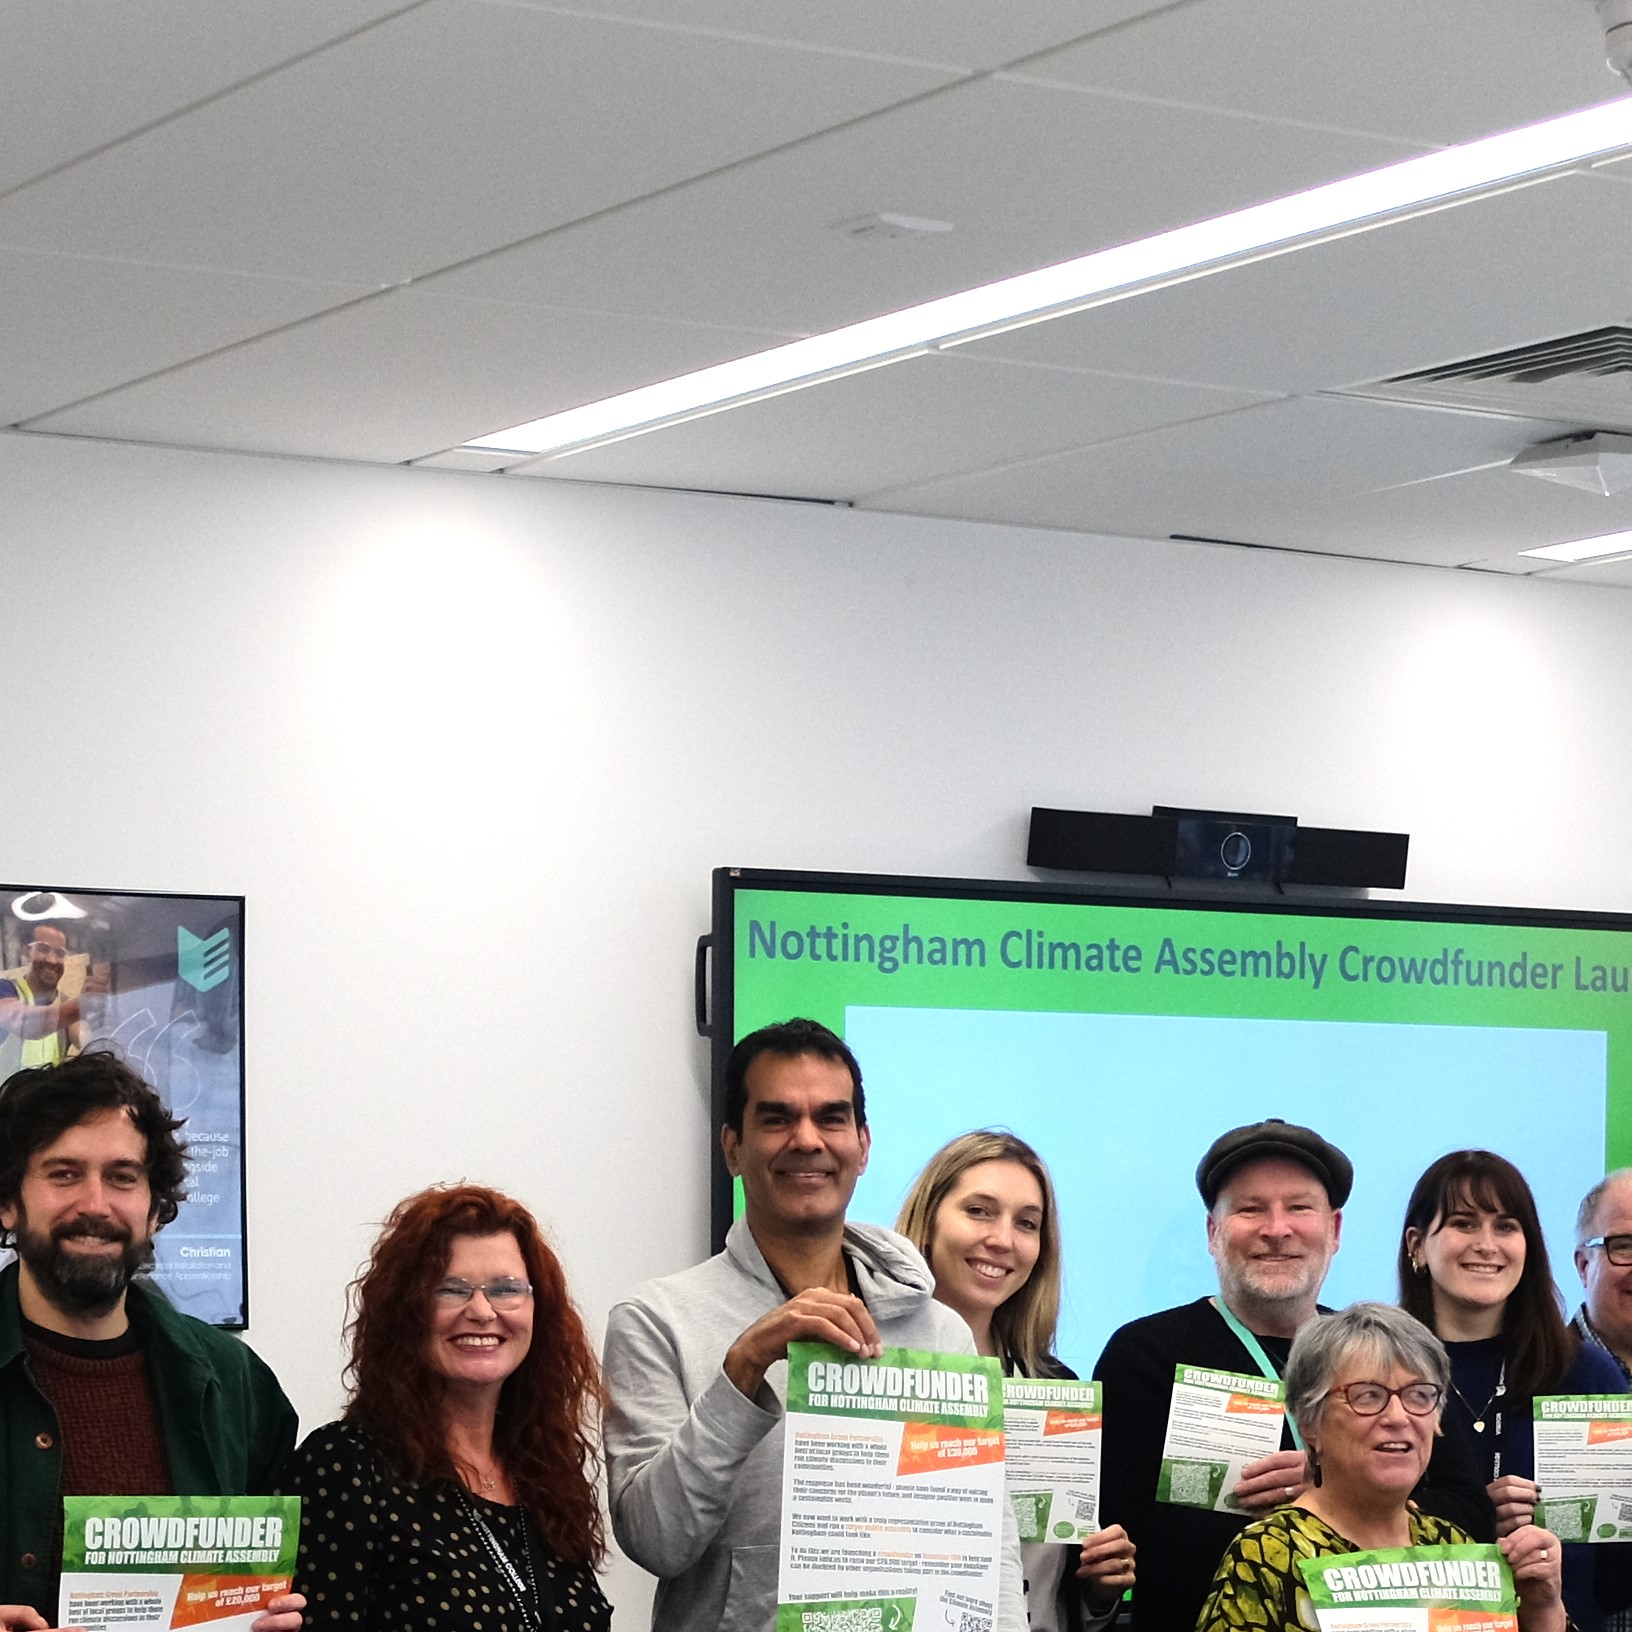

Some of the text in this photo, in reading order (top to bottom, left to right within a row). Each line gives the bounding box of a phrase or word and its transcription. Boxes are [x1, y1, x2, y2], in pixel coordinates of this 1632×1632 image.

[749, 919, 986, 974] Nottingham
[1001, 930, 1142, 974] Climate
[1155, 938, 1326, 989] Assembly
[1339, 945, 1564, 990] Crowdfunder
[187, 1194, 219, 1206] ollege
[180, 1246, 230, 1258] Christian
[807, 1361, 989, 1403] CROWDFUNDER
[1184, 1369, 1279, 1394] CROWDFUNDER
[807, 1394, 829, 1407] FOR
[829, 1395, 898, 1411] NOTTINGHAM
[898, 1399, 940, 1414] CLIMATE
[940, 1402, 989, 1417] ASSEMBLY
[929, 1440, 939, 1449] us
[940, 1438, 962, 1449] reach
[962, 1438, 976, 1447] our
[976, 1437, 1001, 1447] target
[937, 1448, 946, 1458] of
[85, 1516, 283, 1550] CROWDFUNDER
[84, 1549, 280, 1565] FOR NOTTINGHAM CLIMATE ASSEMBLY
[505, 1562, 528, 1593] COLLEGE
[1323, 1560, 1502, 1592] CROWDFUNDER
[185, 1581, 288, 1601] Help us reach our target
[803, 1591, 829, 1600] support
[895, 1587, 918, 1596] reality!
[1331, 1589, 1502, 1604] FOR NOTTINGHAM CLIMATE ASSEMBLY
[214, 1594, 261, 1608] of £20,000
